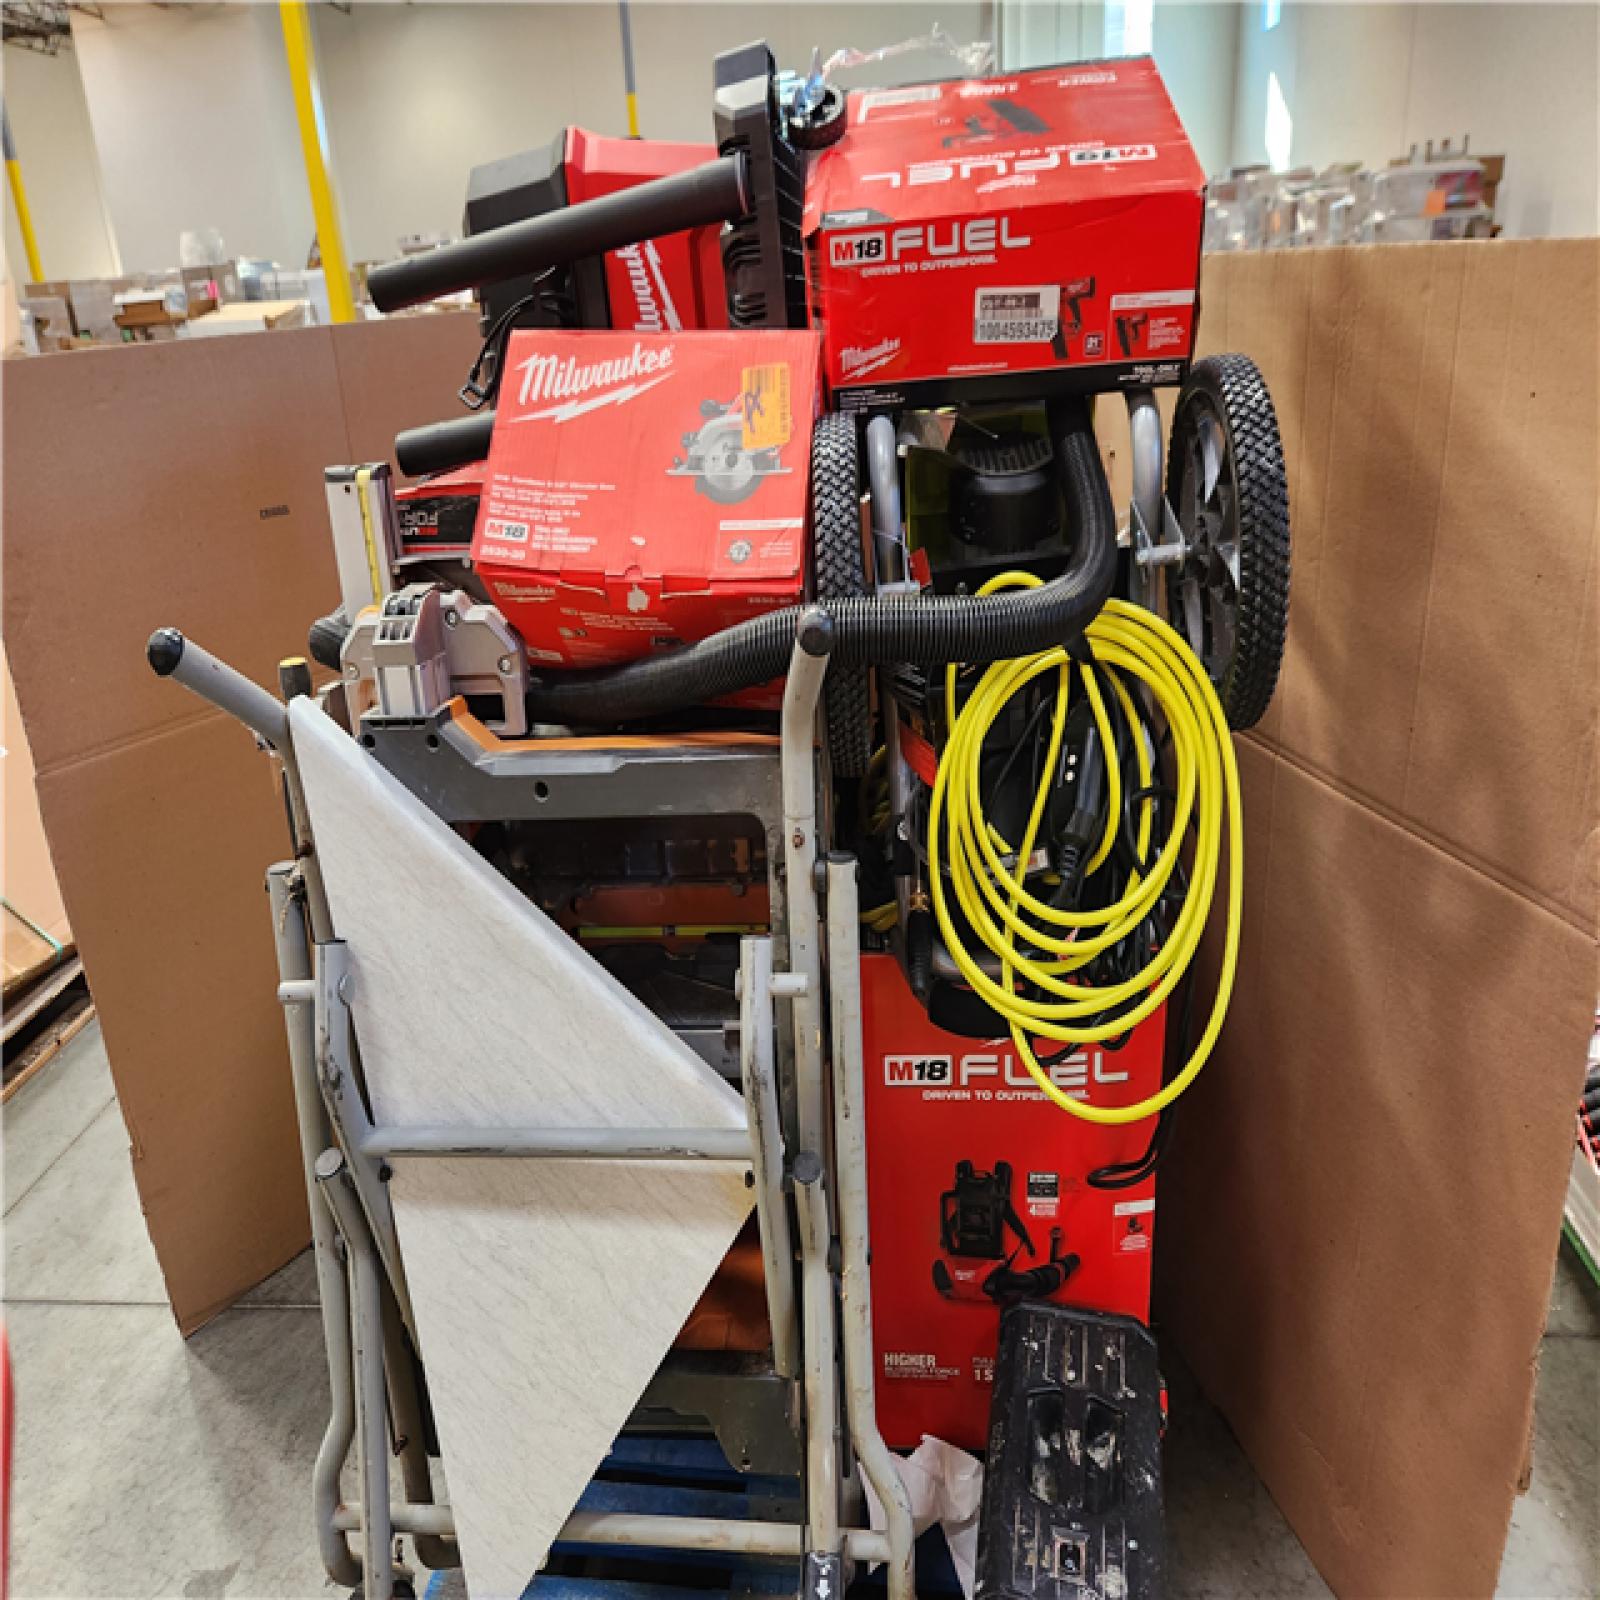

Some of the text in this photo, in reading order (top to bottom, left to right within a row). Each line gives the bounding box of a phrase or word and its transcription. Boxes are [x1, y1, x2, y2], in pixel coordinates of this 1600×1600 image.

[833, 217, 1030, 262] M18 FUEL
[904, 262, 919, 273] TO
[514, 342, 674, 406] Milwaukee
[886, 1058, 950, 1082] M18
[922, 1089, 971, 1100] DRIVEN
[975, 1089, 993, 1100] TO
